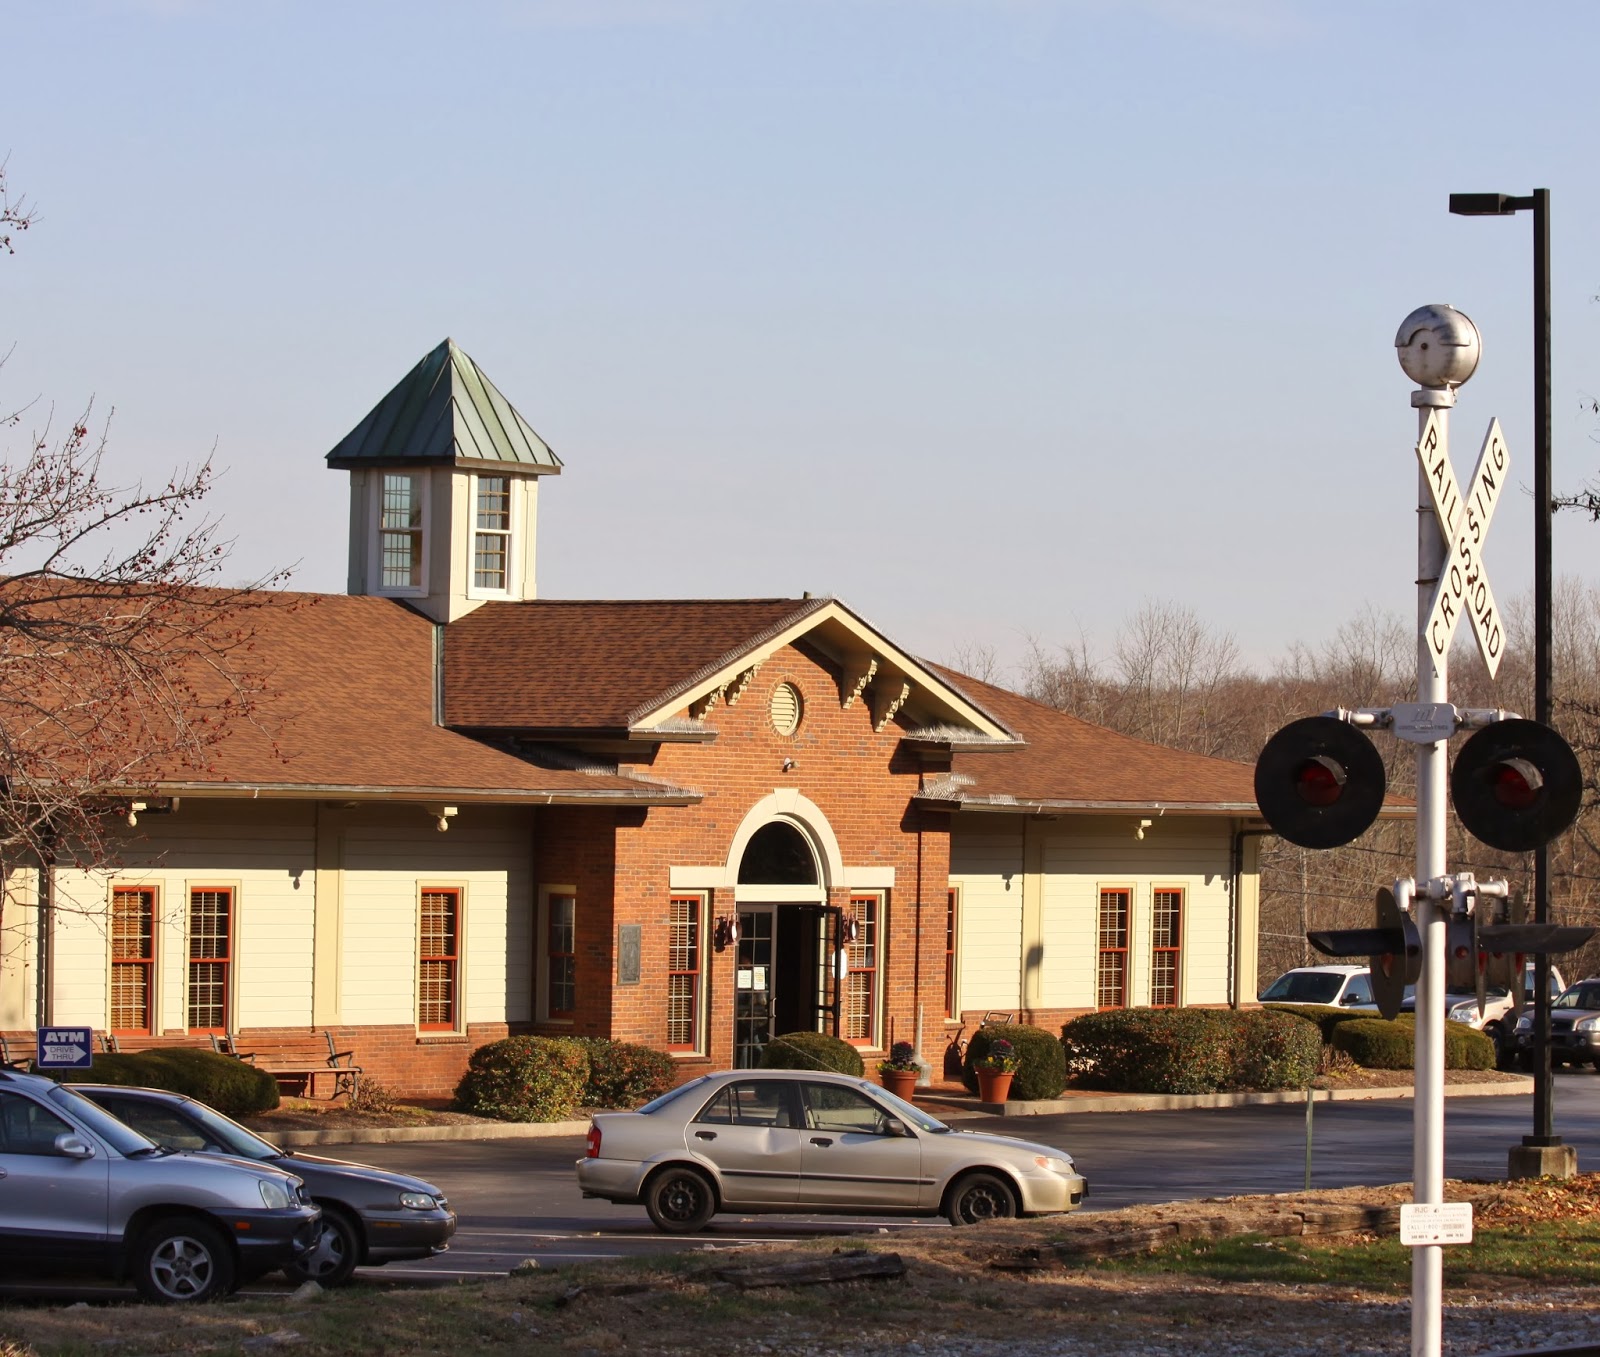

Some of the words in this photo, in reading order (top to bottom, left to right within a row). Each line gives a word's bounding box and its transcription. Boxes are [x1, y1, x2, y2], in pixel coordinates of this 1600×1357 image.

[1424, 424, 1456, 533] RAIL
[1432, 437, 1504, 655] CROSSING
[45, 1031, 85, 1043] ATM
